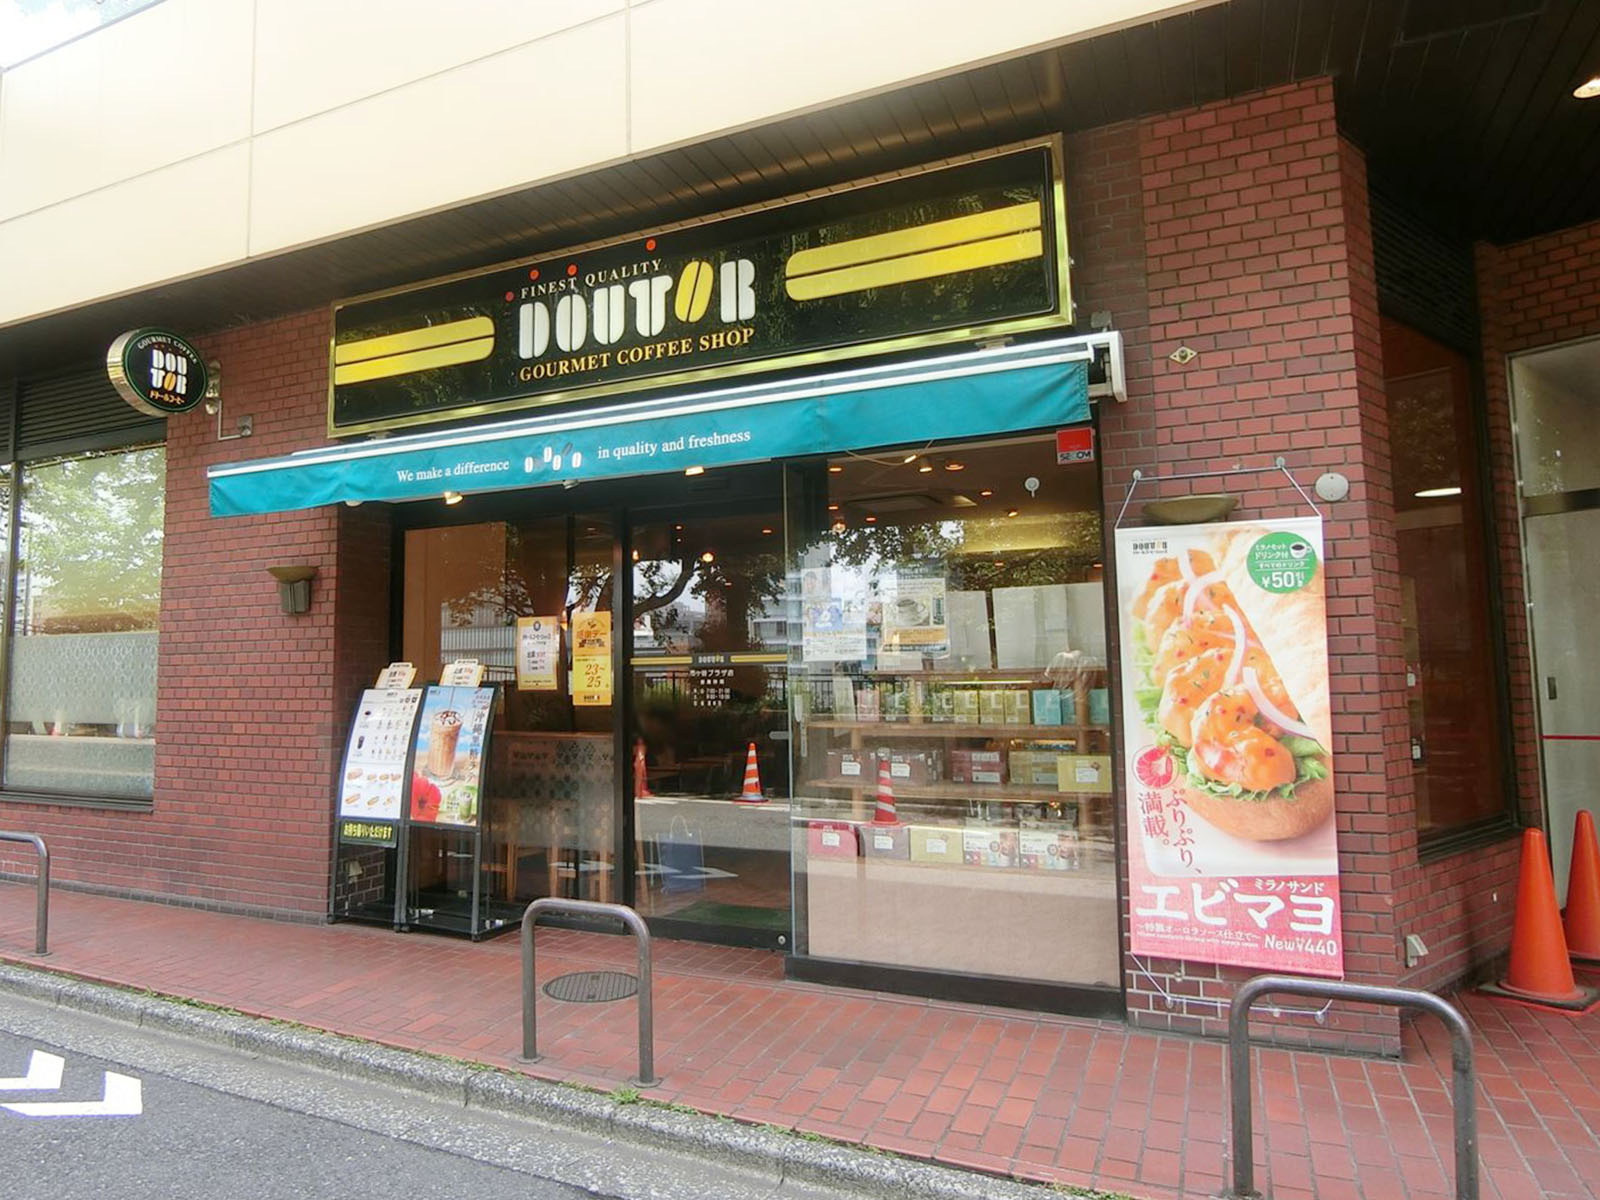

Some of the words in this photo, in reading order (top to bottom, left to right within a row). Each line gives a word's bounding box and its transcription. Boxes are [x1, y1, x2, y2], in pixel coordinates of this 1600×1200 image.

[520, 277, 577, 299] FINEST
[585, 258, 662, 287] QUALITY
[519, 258, 756, 360] DOUTOR
[138, 336, 171, 349] GOURMET
[174, 341, 197, 364] COFFEE
[519, 352, 611, 382] GOURMET
[616, 338, 693, 365] COFFEE
[699, 327, 755, 352] SHOP
[397, 469, 414, 482] We
[416, 467, 443, 481] make
[445, 468, 452, 477] a
[453, 459, 510, 477] difference
[598, 445, 610, 459] in
[613, 438, 658, 460] quality
[661, 438, 685, 453] and
[688, 430, 751, 449] freshness
[1135, 878, 1335, 936] エビマヨ
[1254, 878, 1325, 896] ミラノサンド
